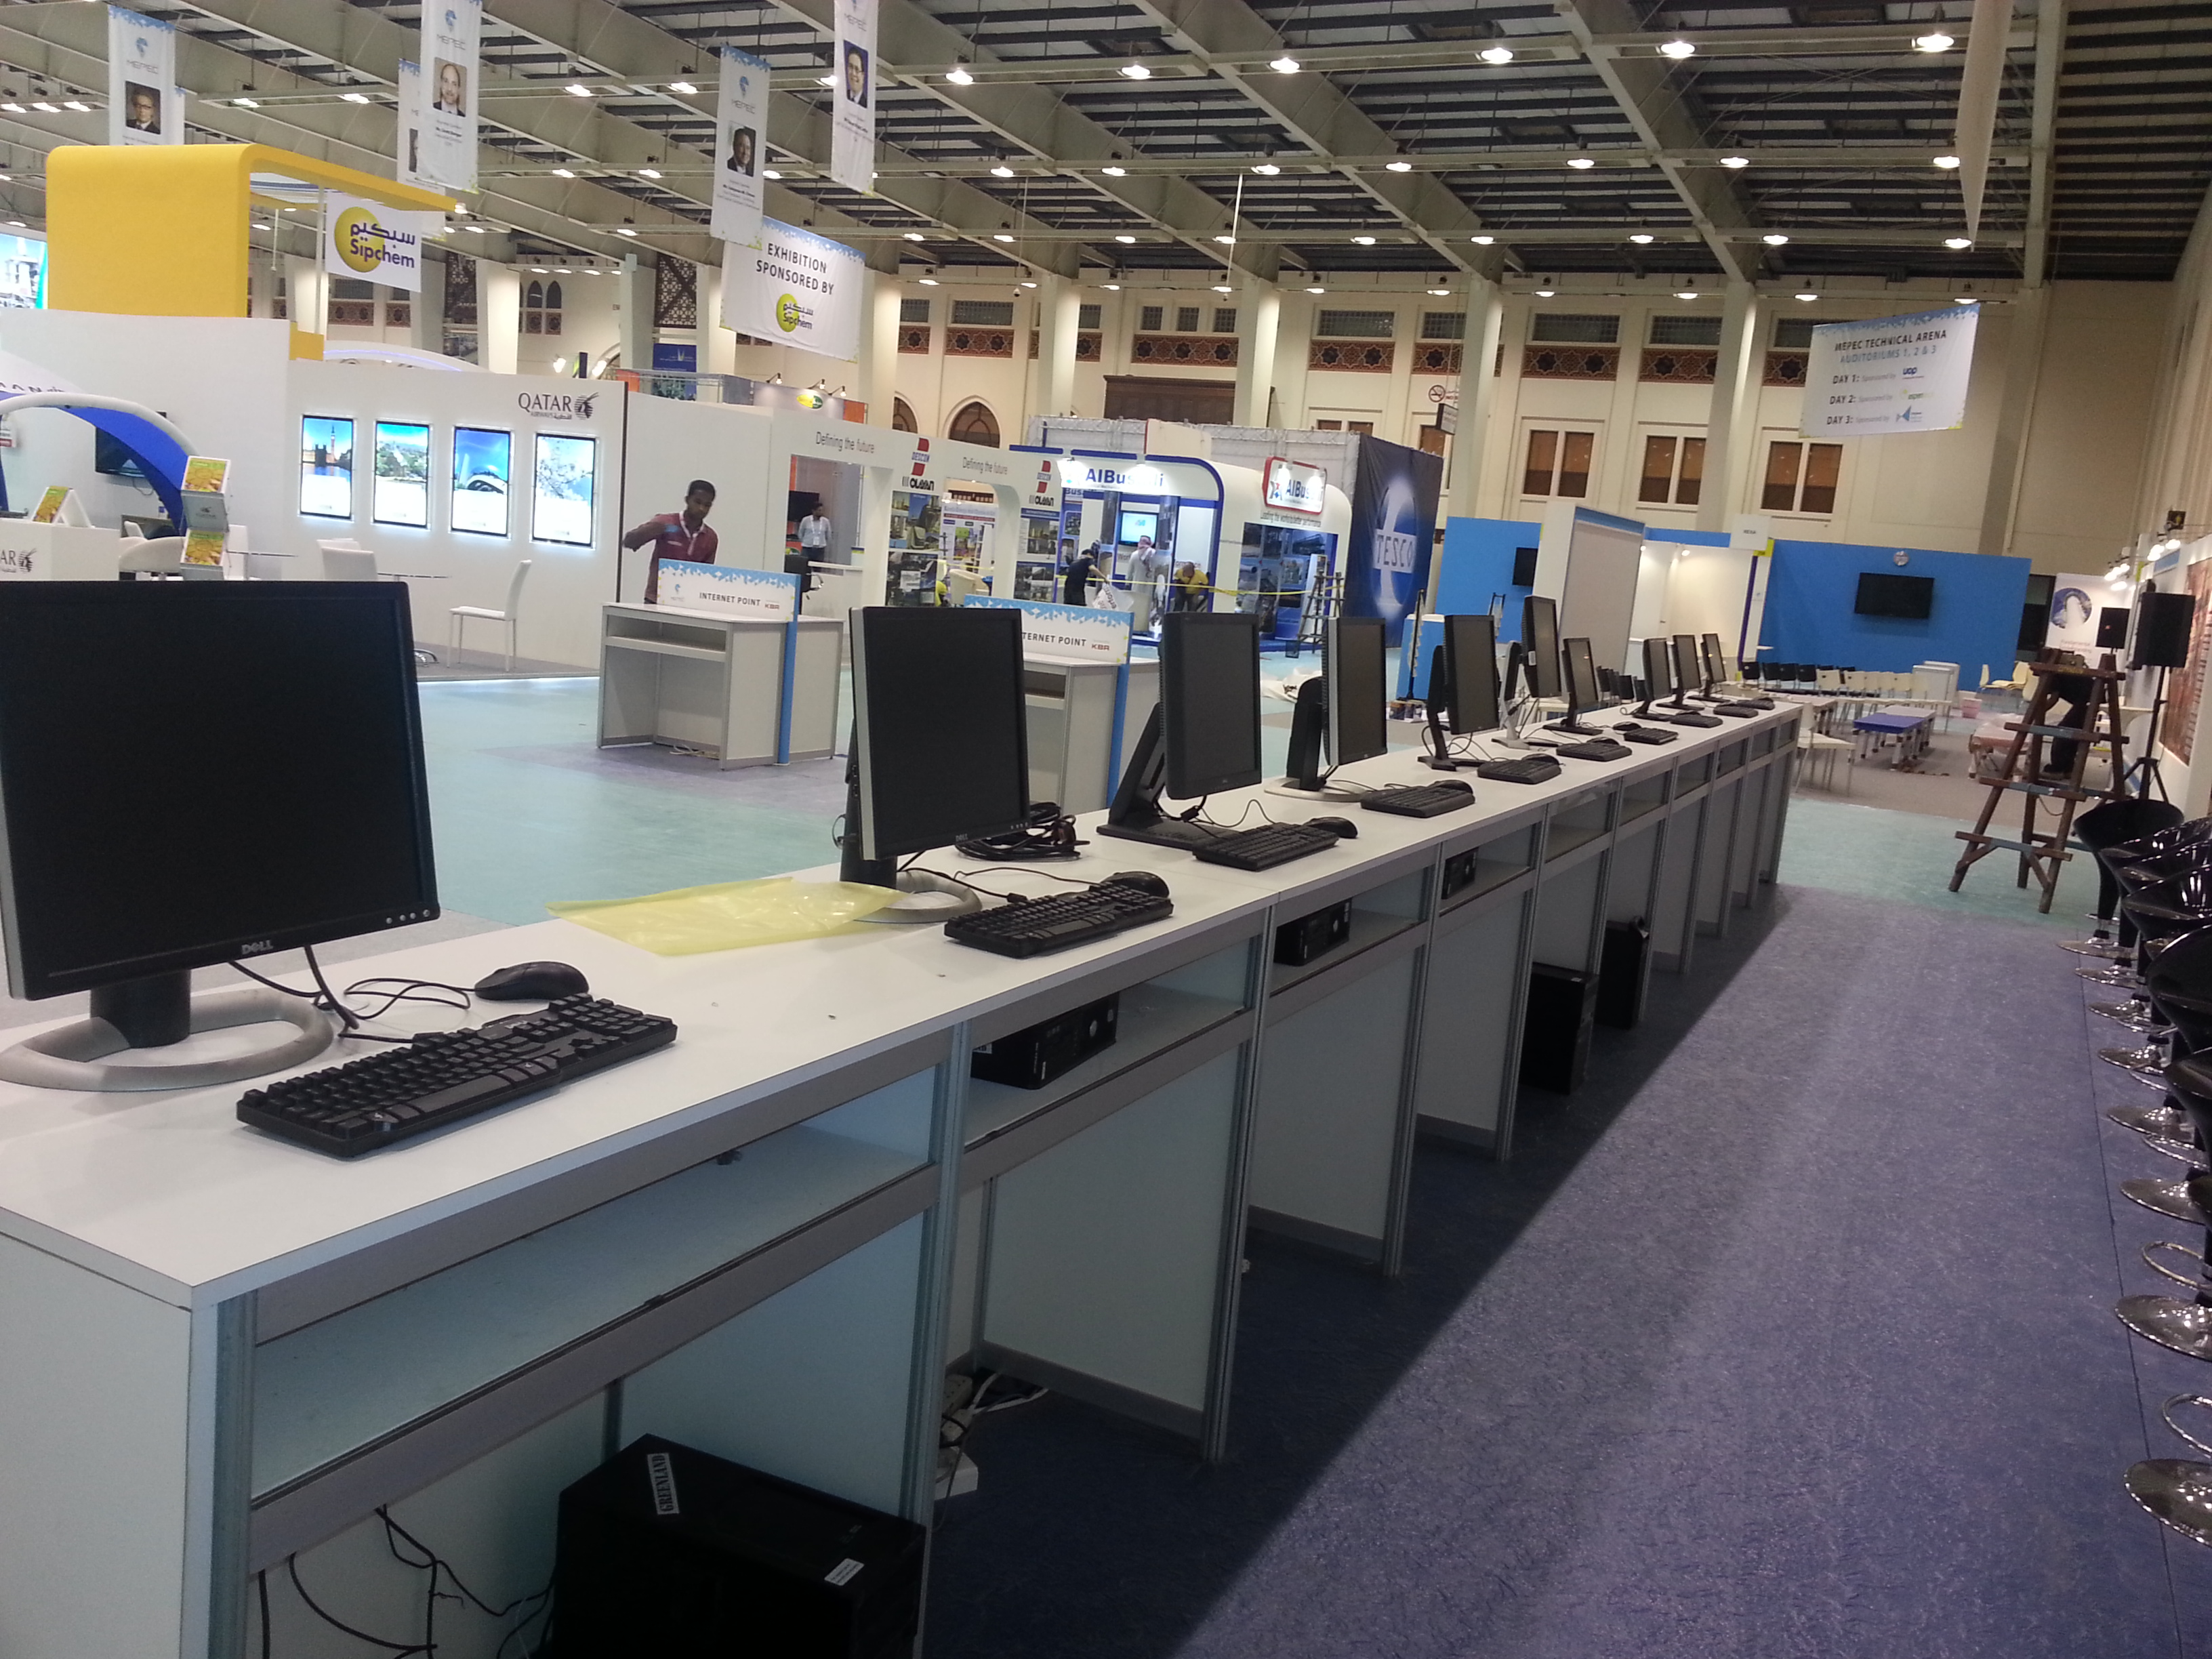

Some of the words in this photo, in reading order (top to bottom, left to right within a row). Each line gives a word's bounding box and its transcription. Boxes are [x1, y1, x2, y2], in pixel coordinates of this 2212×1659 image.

[350, 239, 415, 268] Sipchem
[768, 243, 827, 274] EXHIBITION
[756, 260, 819, 290] SPONSORED
[821, 281, 834, 295] BY
[783, 312, 813, 330] Sipchem
[1835, 340, 1863, 351] MEPEC
[1865, 334, 1913, 348] TECHNICAL
[1916, 329, 1947, 342] ARENA
[1840, 349, 1900, 363] AUDITORIUMS
[1914, 348, 1919, 356] 2
[1922, 346, 1927, 354] &
[1931, 345, 1937, 354] 3
[1832, 374, 1848, 384] DAY
[1851, 374, 1860, 383] 1:
[518, 392, 572, 413] QATAR
[1830, 395, 1846, 405] DAY
[1848, 395, 1856, 403] 2:
[1826, 416, 1843, 425] DAY
[1845, 415, 1853, 424] 3:
[816, 431, 843, 452] Defining
[844, 437, 855, 451] the
[962, 457, 983, 474] Defining
[1376, 534, 1413, 568] TESCO
[699, 592, 735, 603] INTERNET
[737, 597, 760, 607] POINT
[1058, 636, 1086, 647] POINT
[241, 939, 274, 955] DELL
[651, 1454, 674, 1511] GREENLAND
